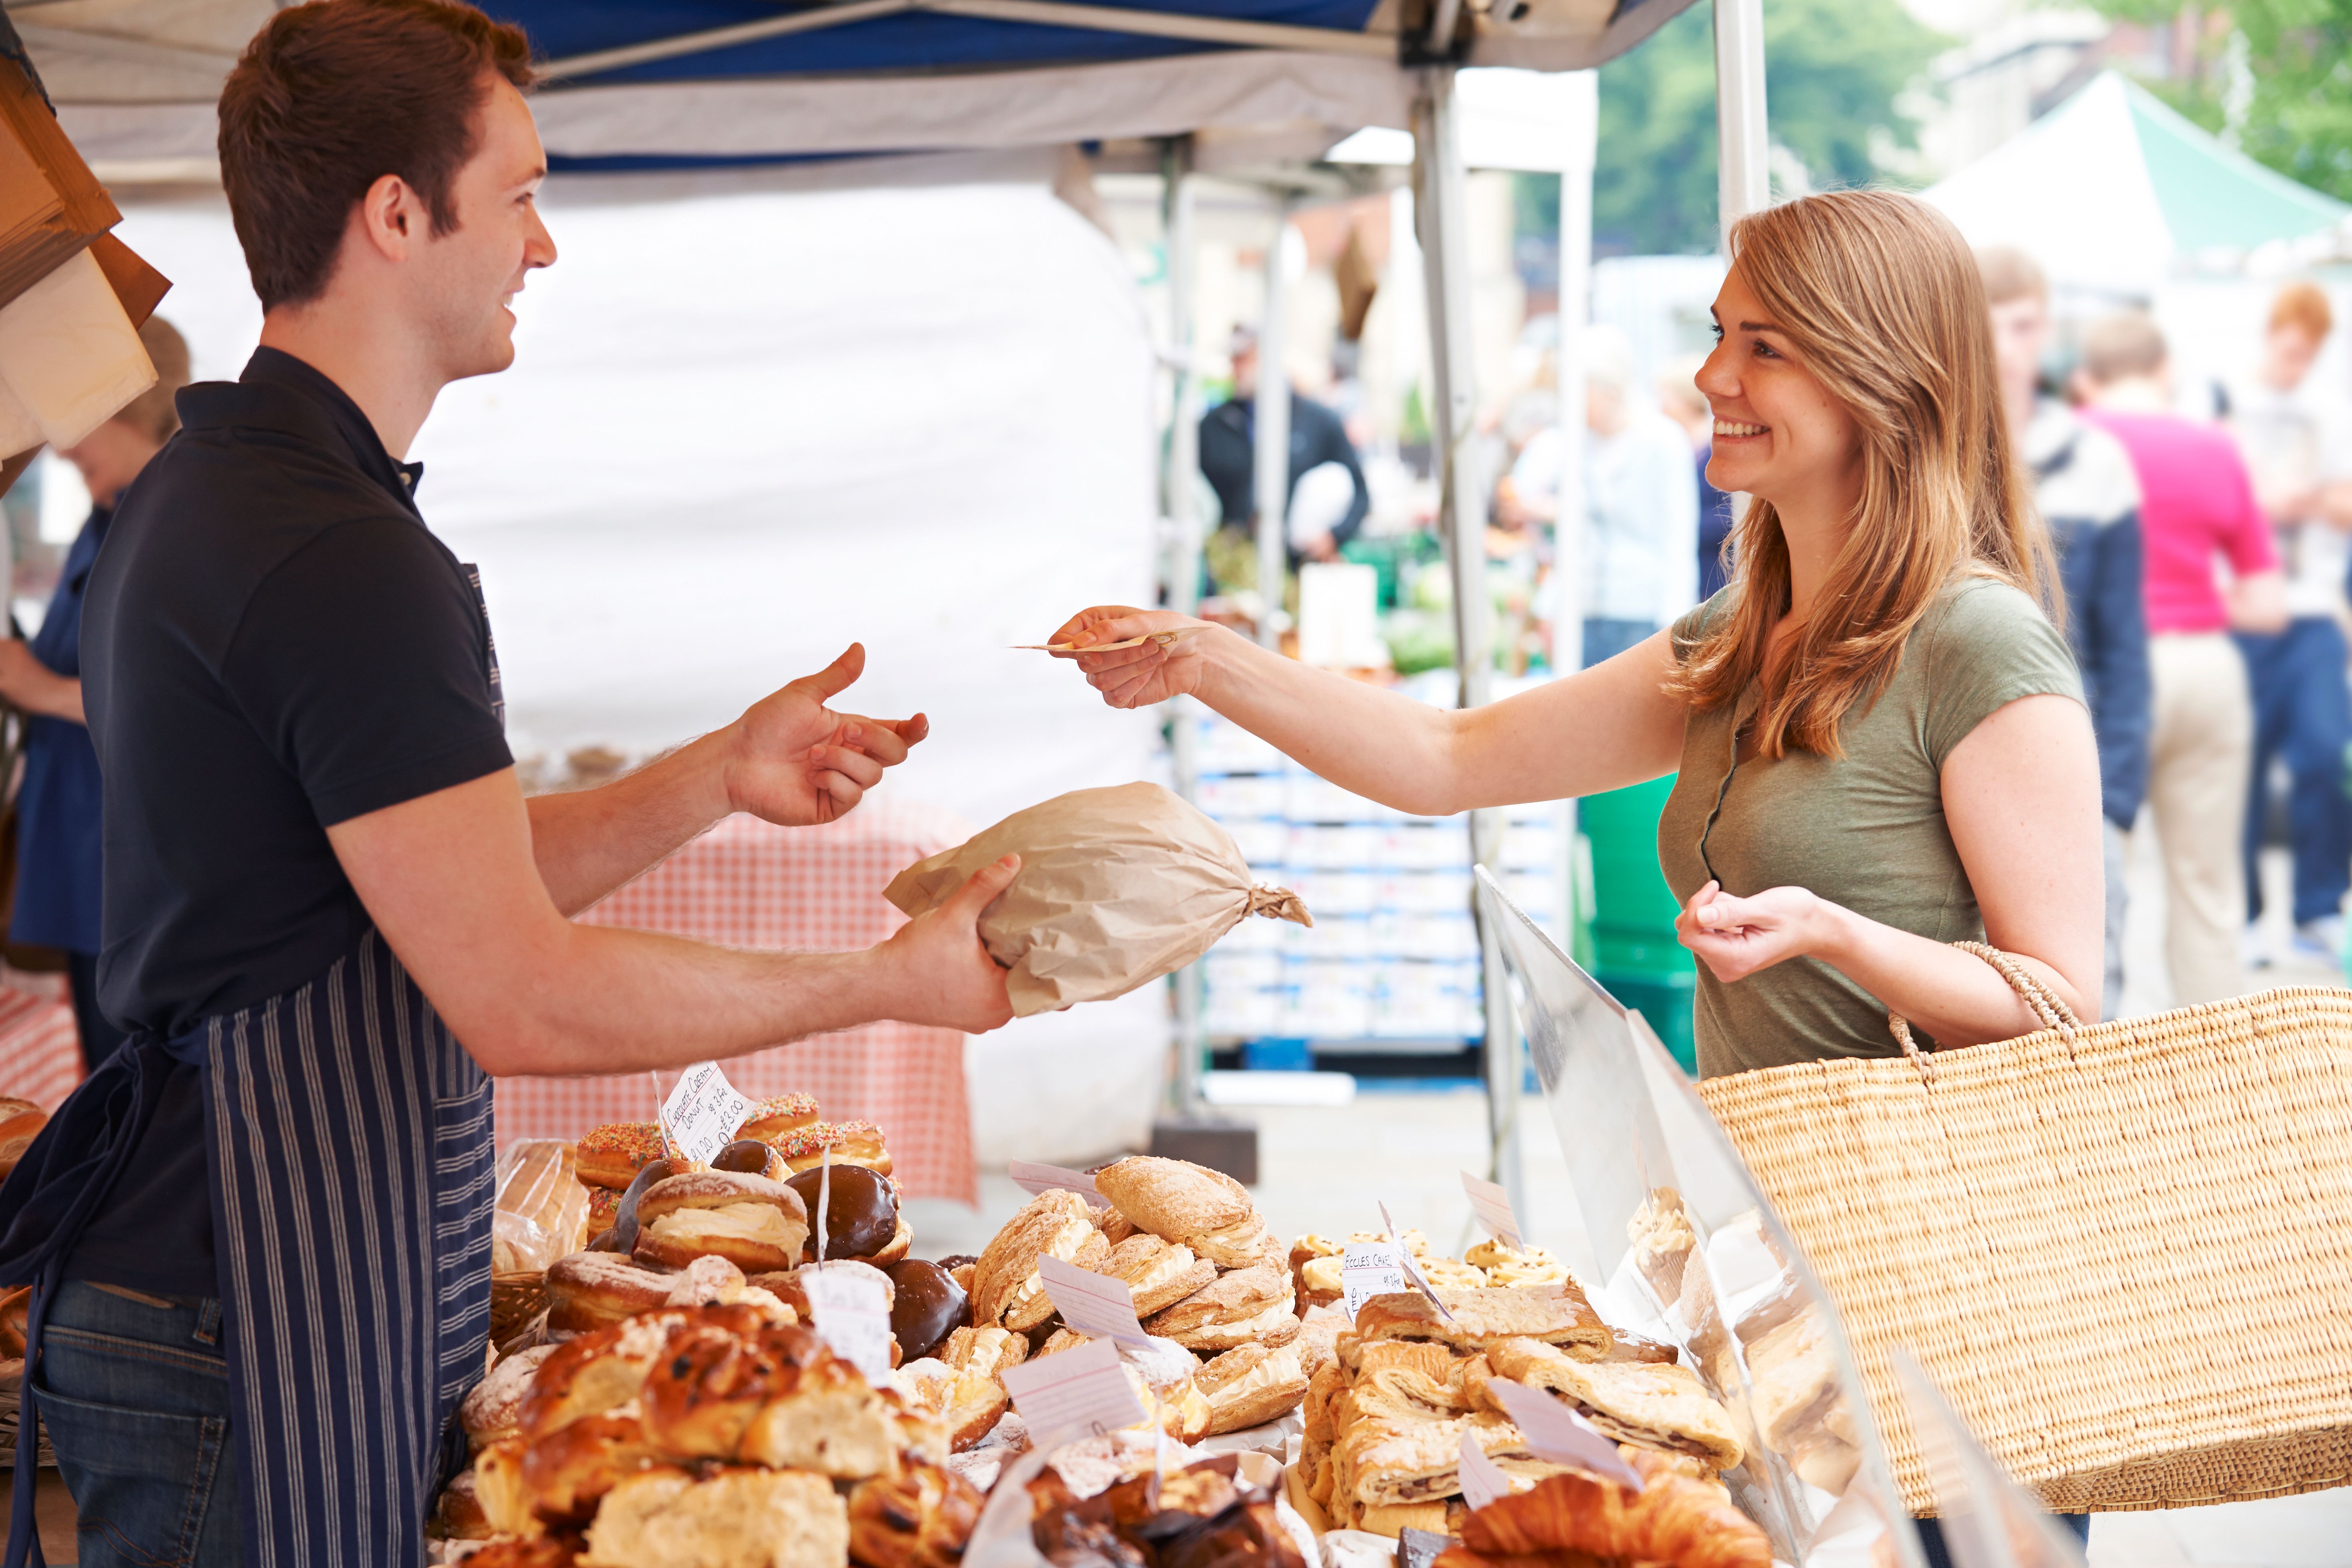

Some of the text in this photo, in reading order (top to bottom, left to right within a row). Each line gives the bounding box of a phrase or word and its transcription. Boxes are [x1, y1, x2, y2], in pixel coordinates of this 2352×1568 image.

[688, 1066, 712, 1093] CREAM
[714, 1096, 721, 1106] 3
[682, 1097, 704, 1129] DONUT
[1345, 1254, 1369, 1269] ECCLES
[1373, 1254, 1392, 1267] CAKES
